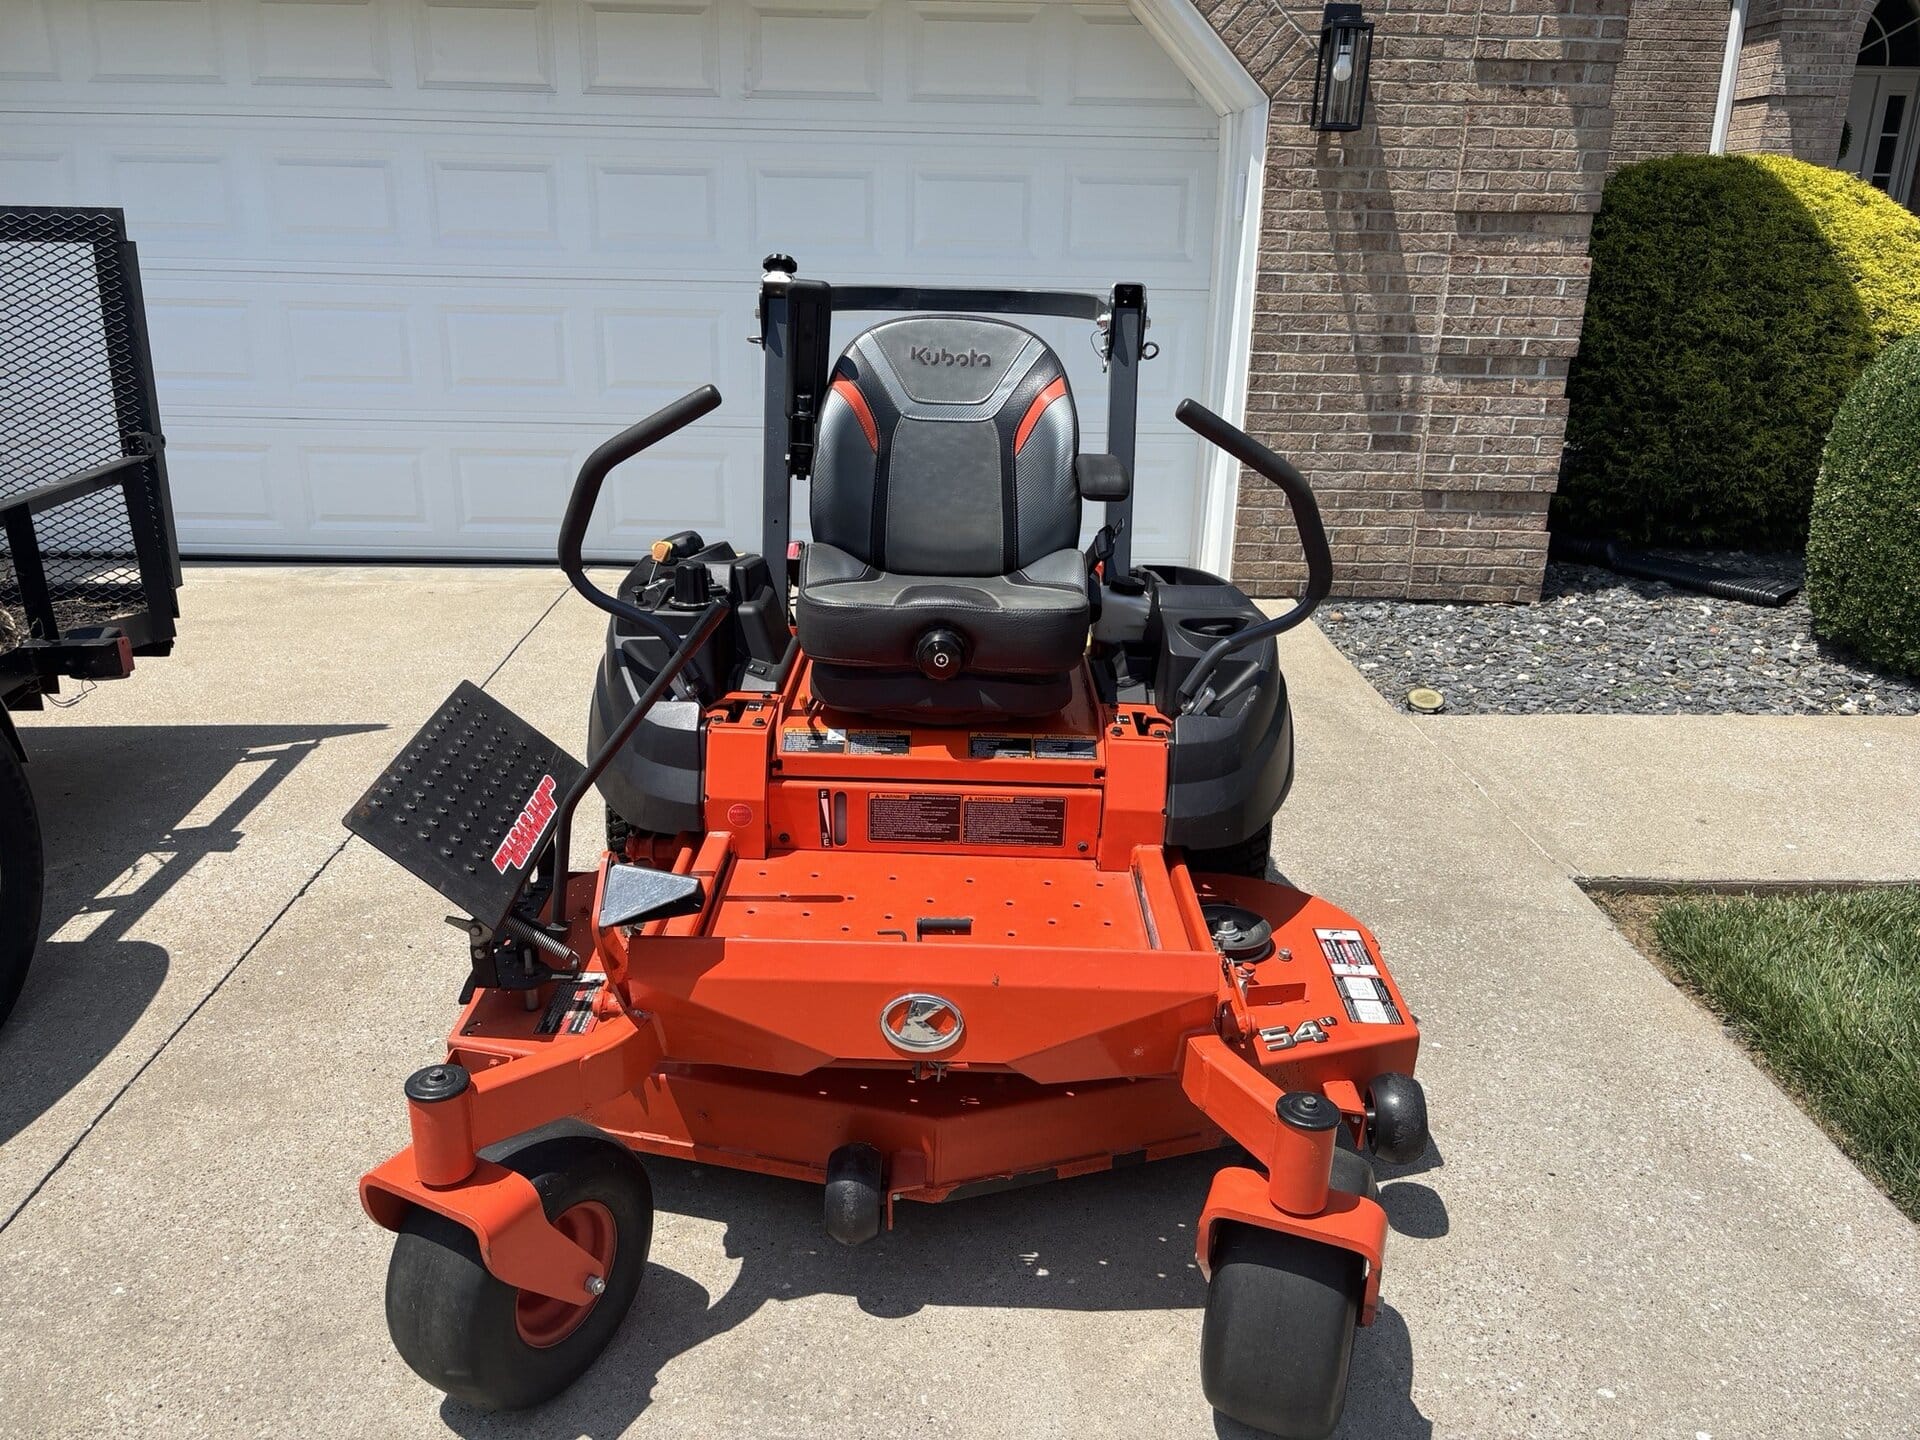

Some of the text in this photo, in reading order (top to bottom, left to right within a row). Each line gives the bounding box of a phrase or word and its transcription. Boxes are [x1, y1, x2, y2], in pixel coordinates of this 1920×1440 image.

[910, 345, 992, 368] Kubota
[493, 775, 555, 872] CHUTE SYSTEM
[511, 797, 557, 868] ADVANCED
